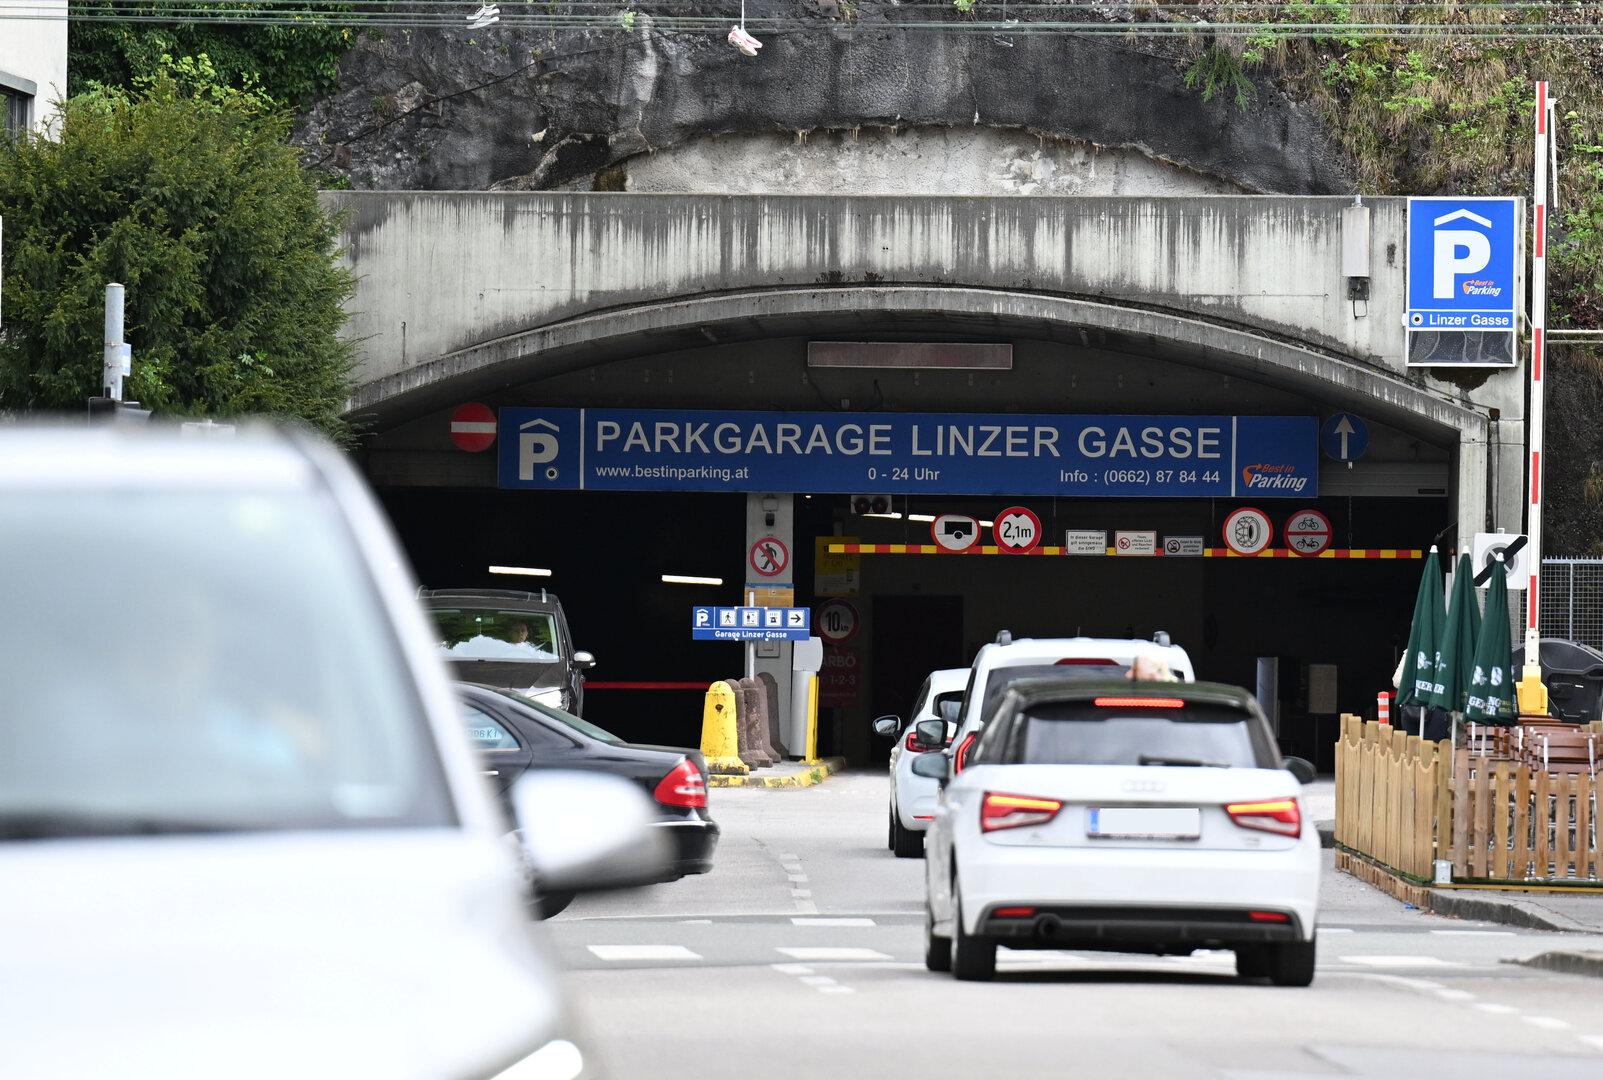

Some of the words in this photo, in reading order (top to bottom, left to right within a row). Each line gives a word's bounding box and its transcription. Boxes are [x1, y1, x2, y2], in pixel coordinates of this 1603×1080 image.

[1467, 285, 1502, 297] Parking
[1429, 314, 1467, 325] Linzer
[1471, 314, 1509, 326] Gasse
[597, 420, 892, 456] PARKGARAGE
[911, 425, 1061, 457] LINZER
[1078, 426, 1221, 459] GASSE
[596, 465, 749, 482] www.bestinparking.at
[868, 467, 877, 480] 0
[891, 467, 909, 480] 24
[914, 467, 941, 481] Uhr
[1060, 469, 1088, 483] Info
[1104, 469, 1151, 485] (0662)
[1155, 470, 1174, 483] 87
[1179, 470, 1197, 483] 84
[1202, 470, 1220, 483] 44
[1248, 473, 1308, 491] Parking
[825, 611, 840, 632] 10
[715, 631, 740, 639] Garage
